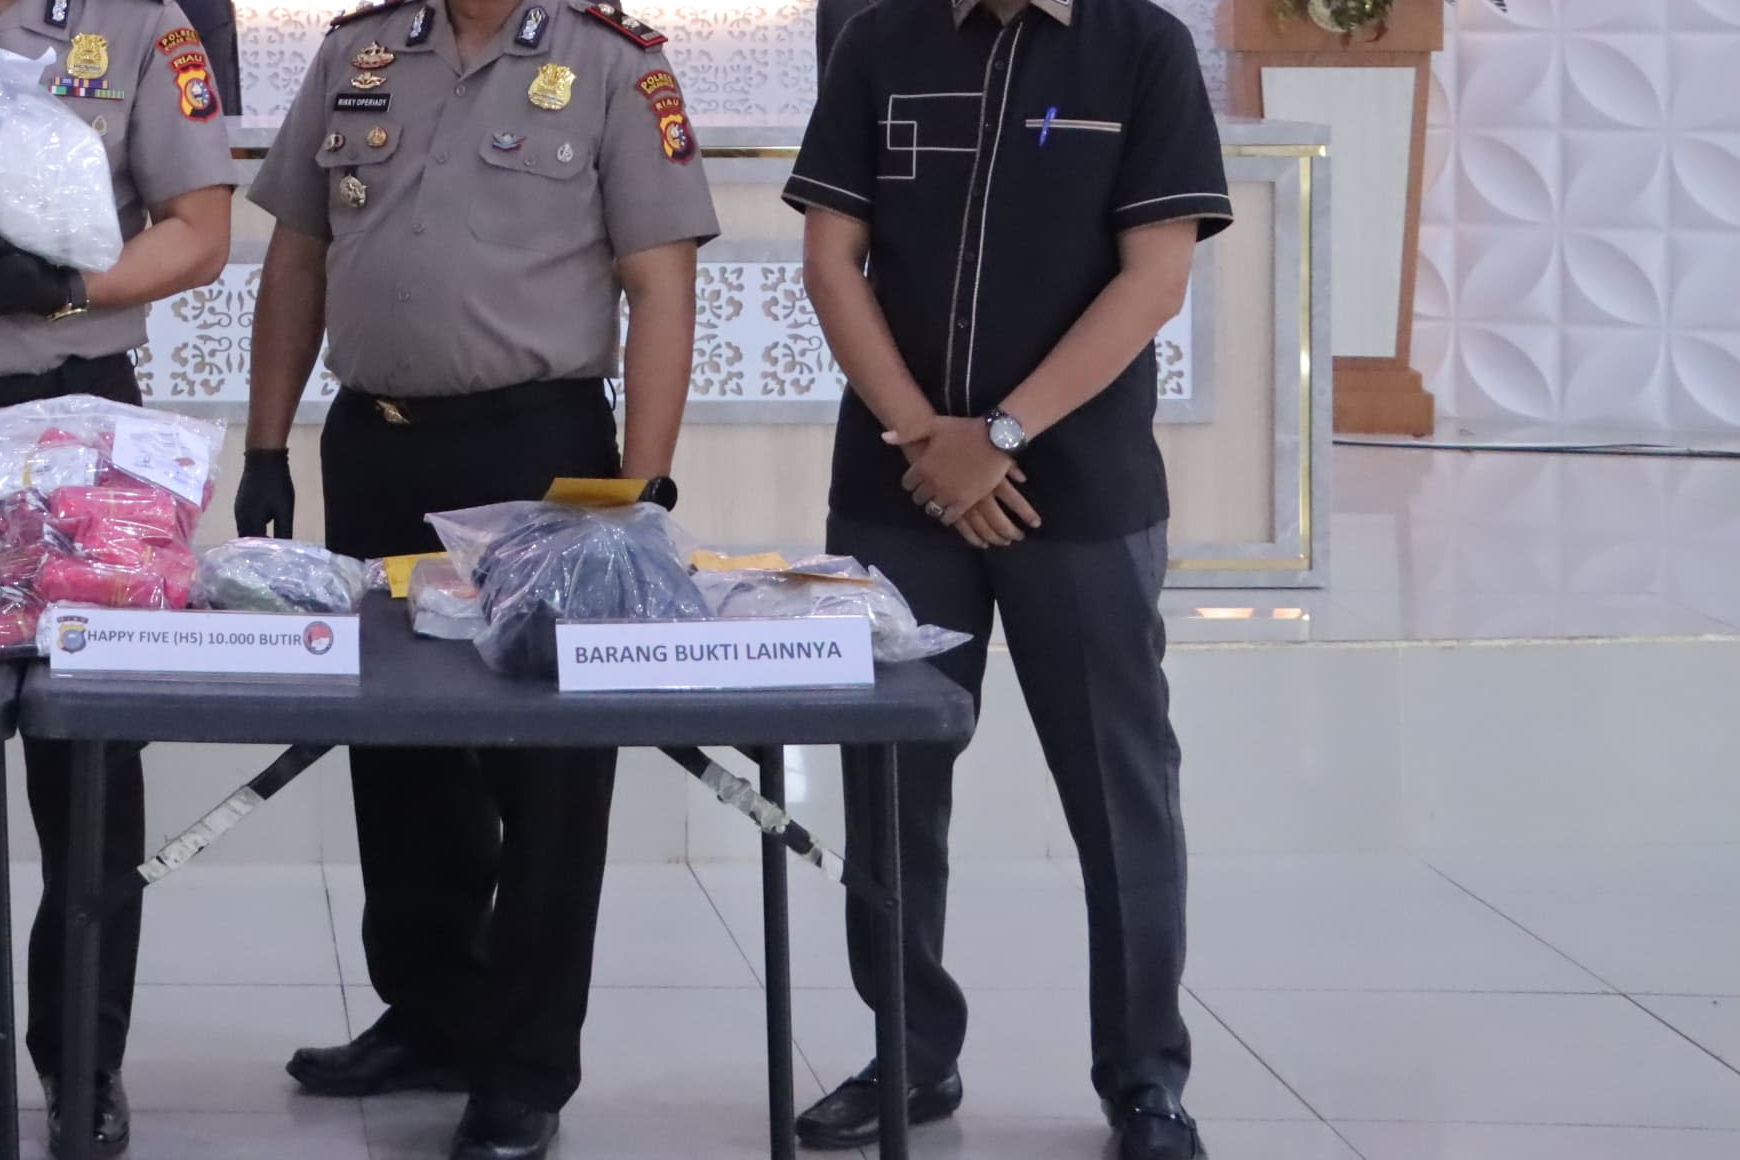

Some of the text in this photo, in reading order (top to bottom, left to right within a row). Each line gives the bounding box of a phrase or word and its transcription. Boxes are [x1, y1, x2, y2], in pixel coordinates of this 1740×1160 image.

[173, 54, 202, 67] RIAU
[656, 99, 679, 110] RIAU
[87, 629, 135, 643] HAPPY
[139, 630, 169, 644] FIVE
[173, 631, 203, 647] (H5)
[208, 632, 255, 646] 10.000
[259, 633, 303, 646] BUTIR
[575, 641, 842, 664] BARANG BUKTI LAINNYA
